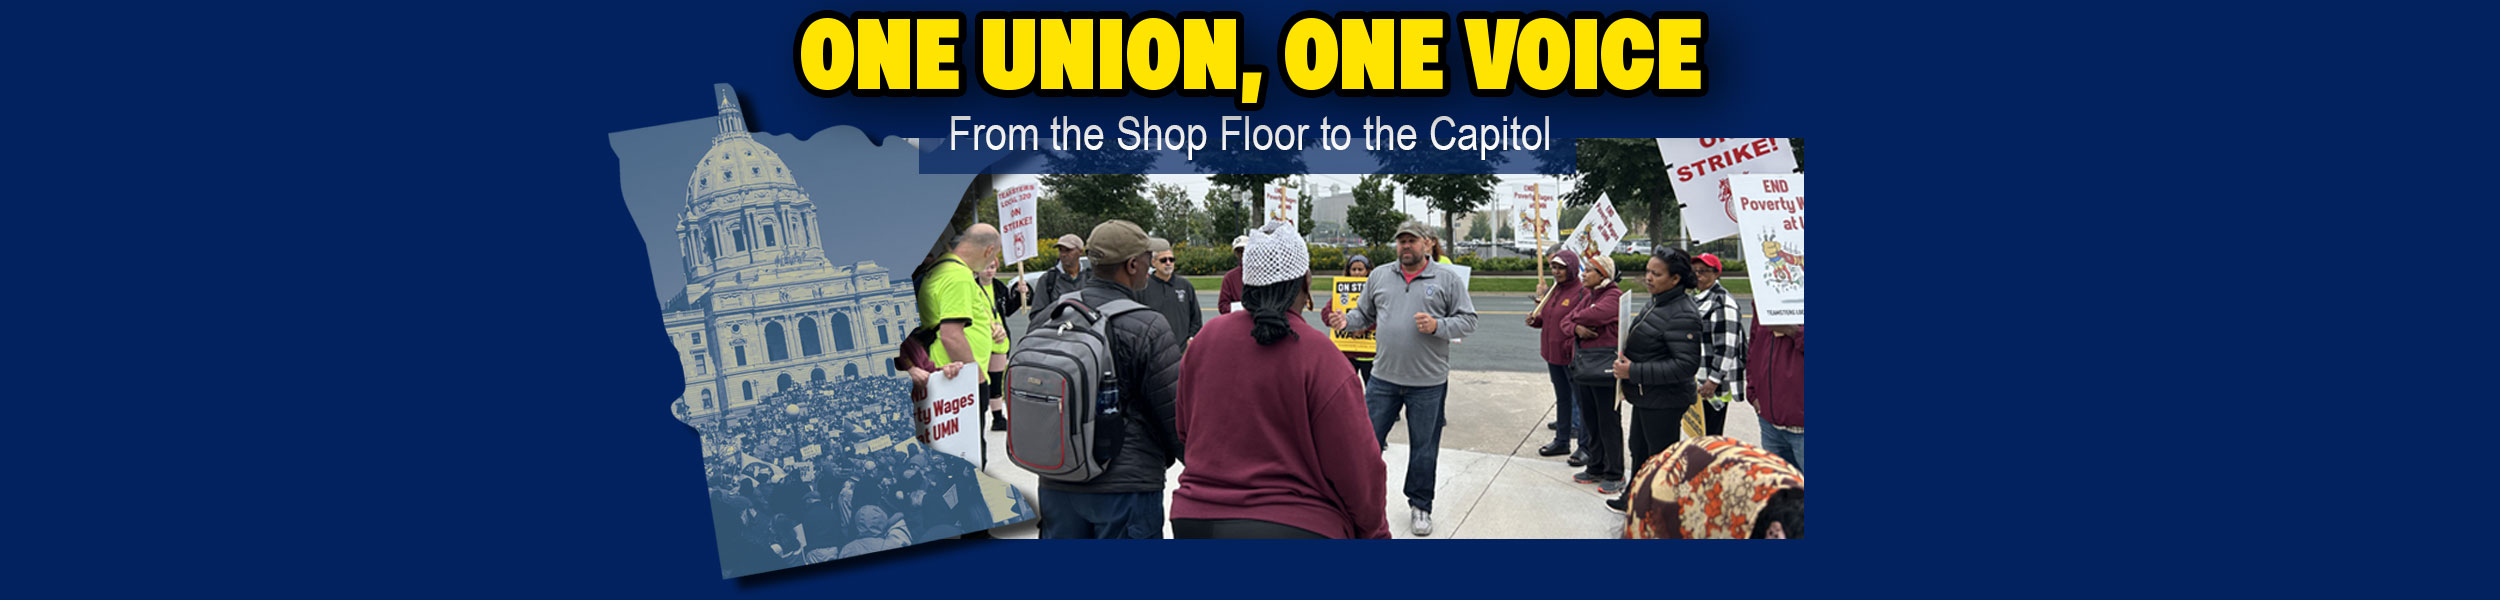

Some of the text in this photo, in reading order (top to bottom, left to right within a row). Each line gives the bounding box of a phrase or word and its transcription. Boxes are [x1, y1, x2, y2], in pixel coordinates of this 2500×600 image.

[1676, 138, 1779, 182] STRIKE!
[1762, 179, 1790, 193] END
[1740, 196, 1797, 214] Poverty
[1782, 216, 1798, 231] at
[1338, 283, 1350, 292] ON
[933, 393, 975, 417] Wages
[933, 417, 960, 441] UMN
